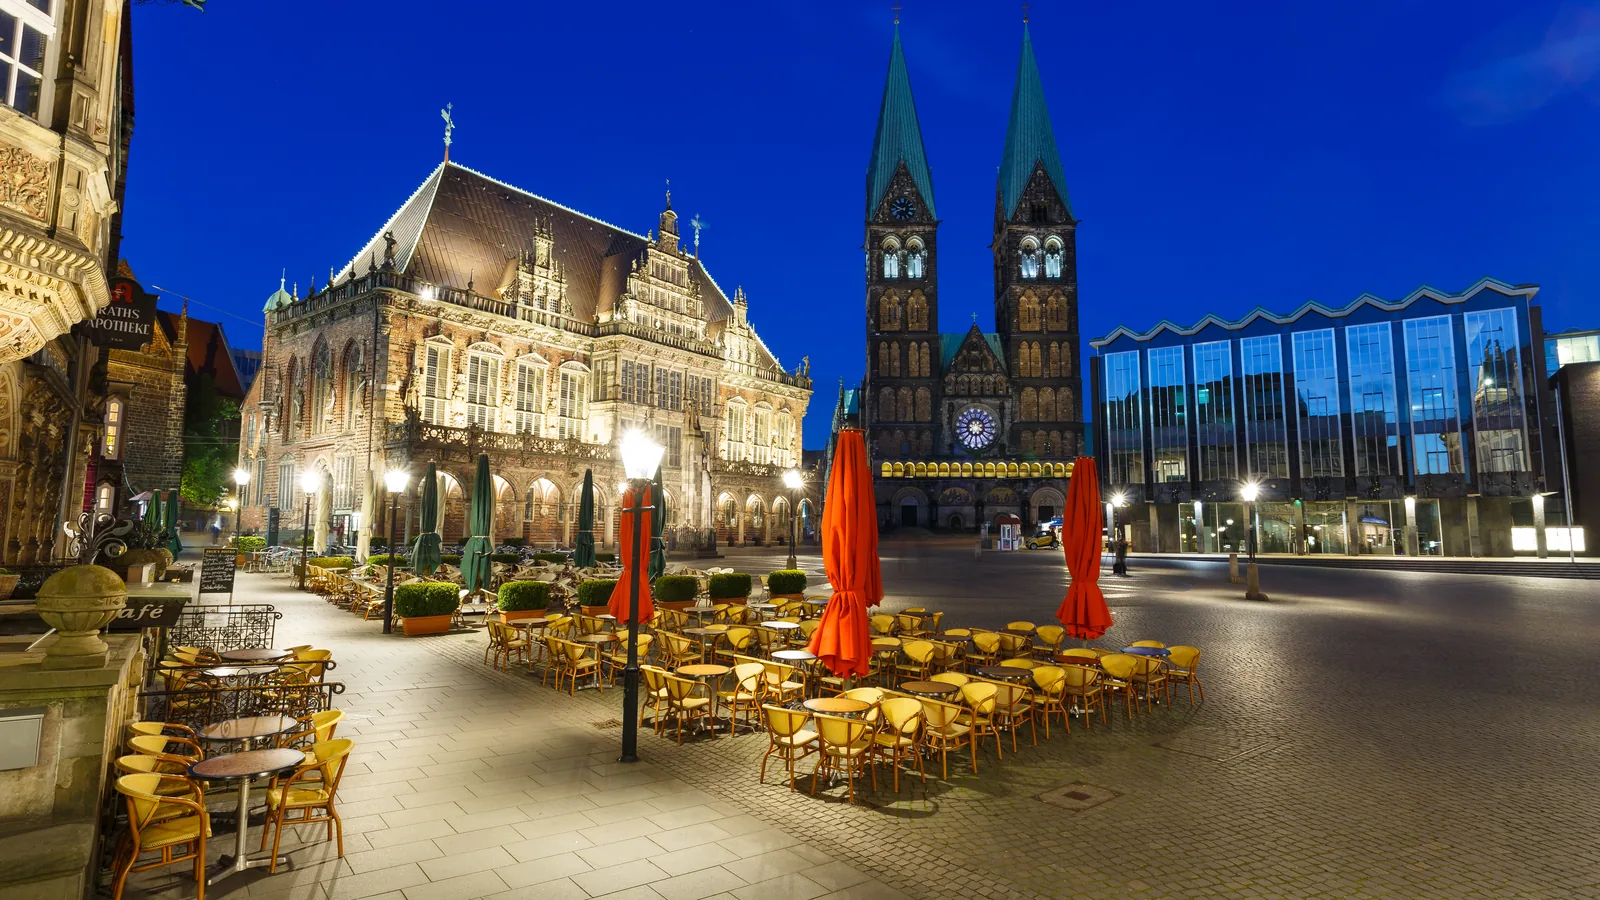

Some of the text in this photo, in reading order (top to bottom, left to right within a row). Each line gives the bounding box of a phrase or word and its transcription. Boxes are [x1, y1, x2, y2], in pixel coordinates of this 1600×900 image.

[98, 306, 140, 319] RATHS
[85, 318, 150, 335] APOTHEKE
[118, 604, 164, 621] afé
